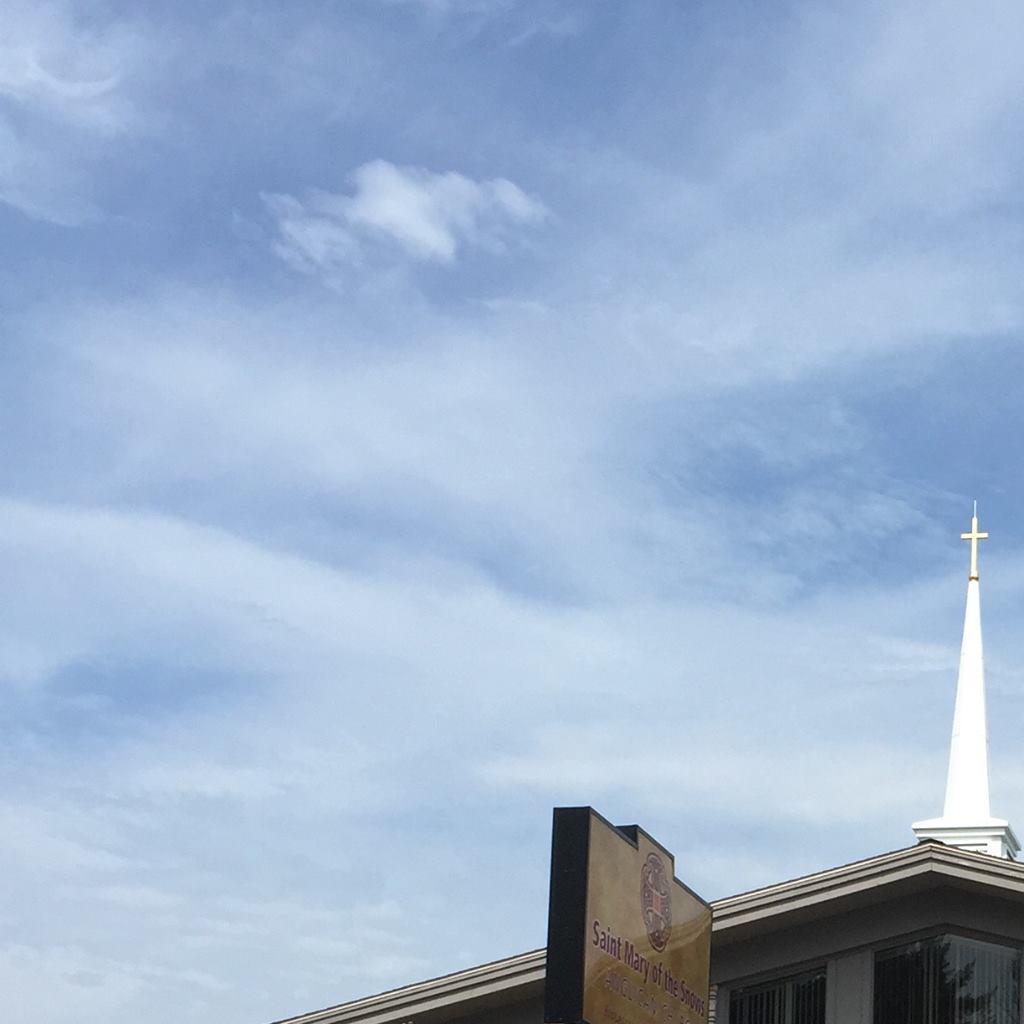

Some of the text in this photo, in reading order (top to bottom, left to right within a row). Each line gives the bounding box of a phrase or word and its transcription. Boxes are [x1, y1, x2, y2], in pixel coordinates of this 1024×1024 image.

[592, 920, 705, 1017] Saint Mary of the Snows
